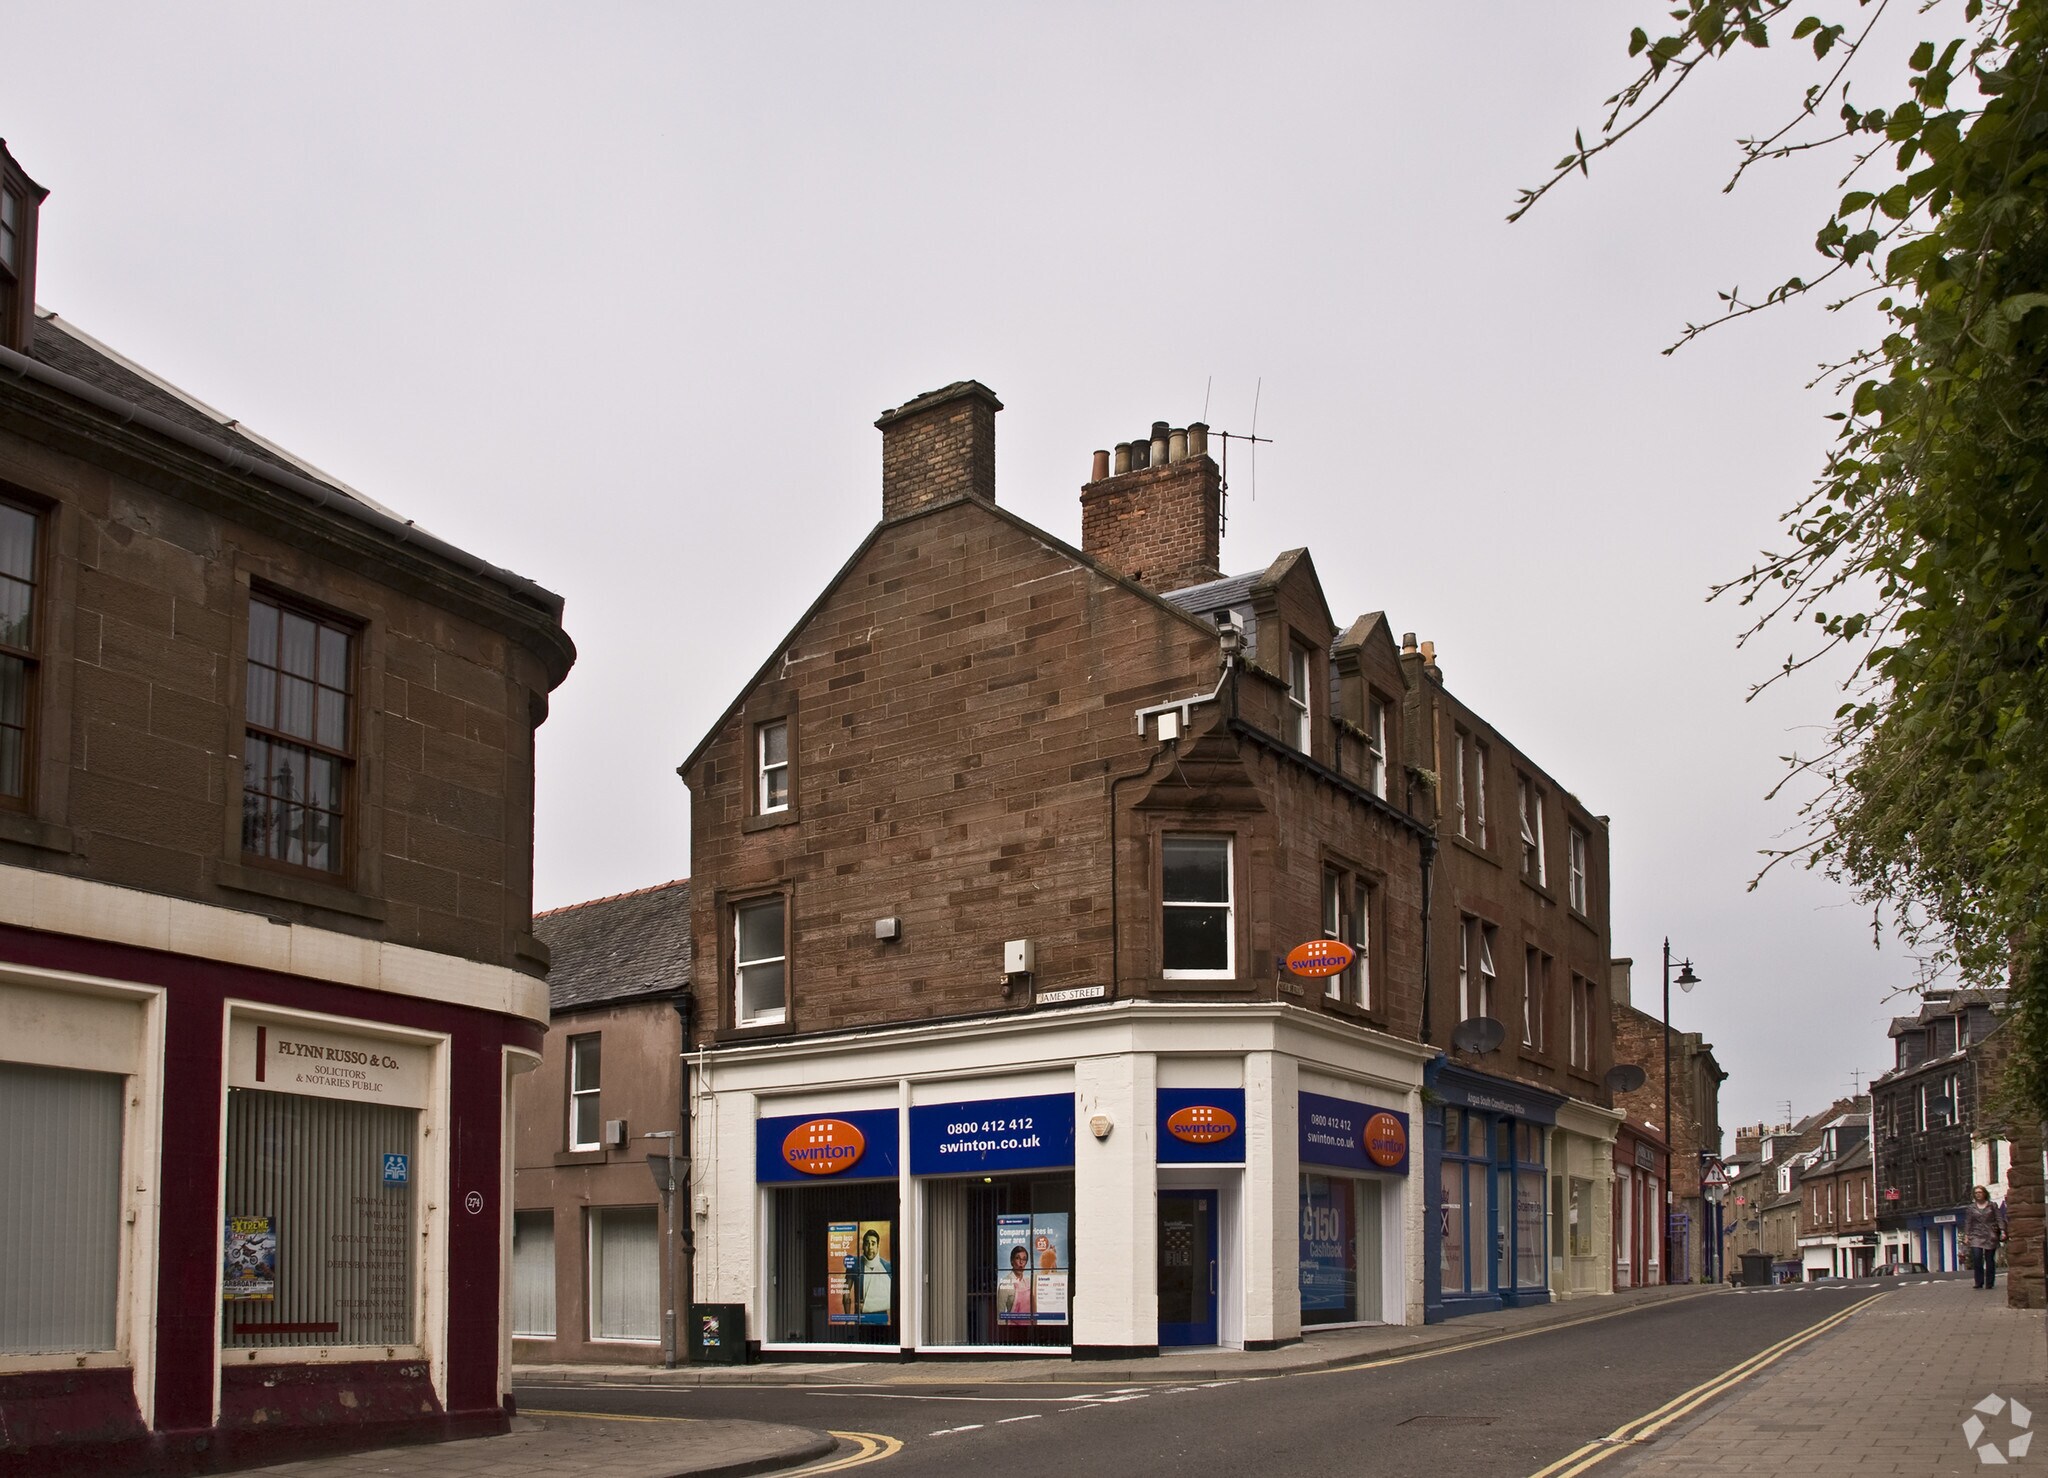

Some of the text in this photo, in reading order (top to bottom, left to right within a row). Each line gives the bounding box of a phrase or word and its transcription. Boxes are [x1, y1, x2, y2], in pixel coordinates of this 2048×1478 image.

[1291, 956, 1346, 969] swinton
[1040, 988, 1100, 1003] JAMES STREET
[279, 1041, 400, 1070] FLYNN RUSSO & Co.
[314, 1065, 366, 1080] SOLICITORS
[296, 1073, 383, 1092] & NOTARIES PUBLIC
[947, 1118, 1033, 1135] 0800 412 412
[1174, 1122, 1231, 1134] swinton
[1311, 1114, 1351, 1131] 0800 412 412
[939, 1134, 1041, 1154] swinton.co.uk
[1307, 1131, 1355, 1149] swinton.co.uk
[1372, 1138, 1404, 1154] swinton
[789, 1143, 855, 1161] swinton
[351, 1196, 407, 1207] CRIMINAL LAW
[468, 1198, 480, 1208] 274
[359, 1210, 407, 1220] FAMILY LAW
[231, 1219, 269, 1233] EXTREME
[373, 1223, 408, 1232] DIVORCE
[999, 1228, 1025, 1237] Compare
[1310, 1241, 1343, 1258] Cashback
[372, 1274, 407, 1283] HOUSING
[1302, 1271, 1314, 1284] Car
[370, 1287, 407, 1296] BENEFITS
[351, 1312, 373, 1320] ROAD
[382, 1325, 406, 1333] WILLS
